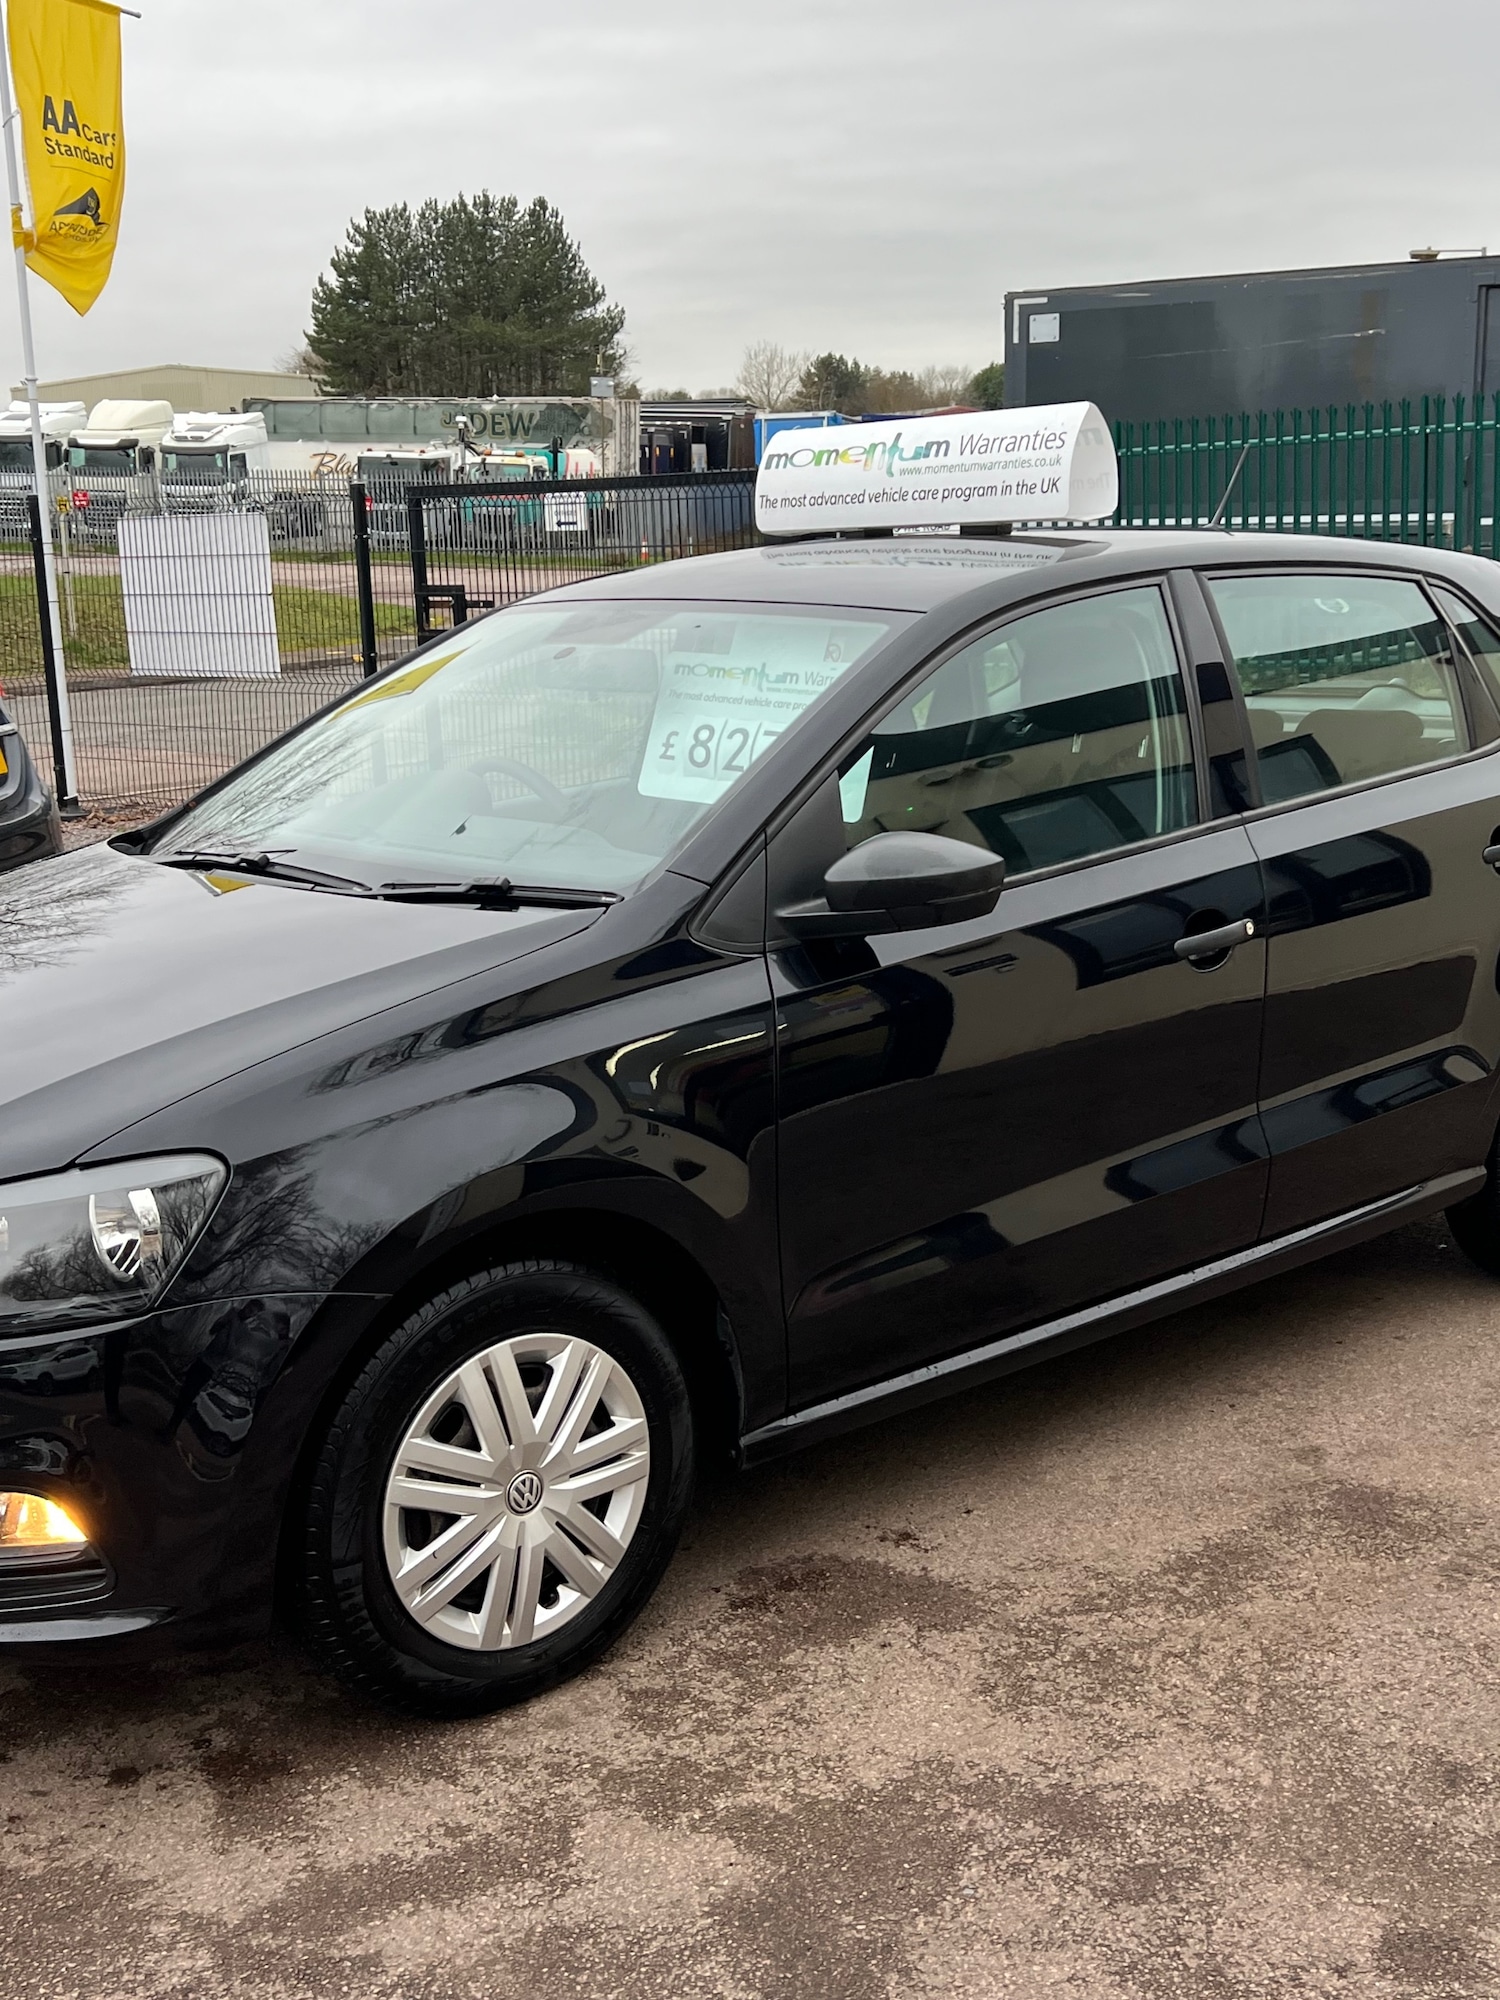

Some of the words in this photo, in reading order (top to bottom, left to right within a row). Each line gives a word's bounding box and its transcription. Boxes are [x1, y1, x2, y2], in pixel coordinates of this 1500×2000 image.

[43, 95, 81, 138] AA
[44, 136, 114, 169] Standard
[469, 410, 536, 437] DEW
[764, 433, 950, 477] momentum
[960, 427, 1067, 457] Warranties
[899, 454, 1062, 477] www.momentumwarranties.co.uk
[759, 494, 778, 510] The
[780, 494, 806, 508] most
[808, 488, 866, 507] advanced
[868, 486, 909, 503] vehicle
[911, 487, 939, 502] care
[941, 483, 998, 503] program
[1001, 480, 1012, 497] in
[1015, 479, 1037, 496] the
[1040, 476, 1062, 494] UK
[674, 662, 800, 693] momentum
[669, 689, 681, 699] The
[683, 691, 703, 701] most
[704, 692, 745, 706] advanced
[745, 696, 773, 708] vehicle
[773, 701, 791, 710] care
